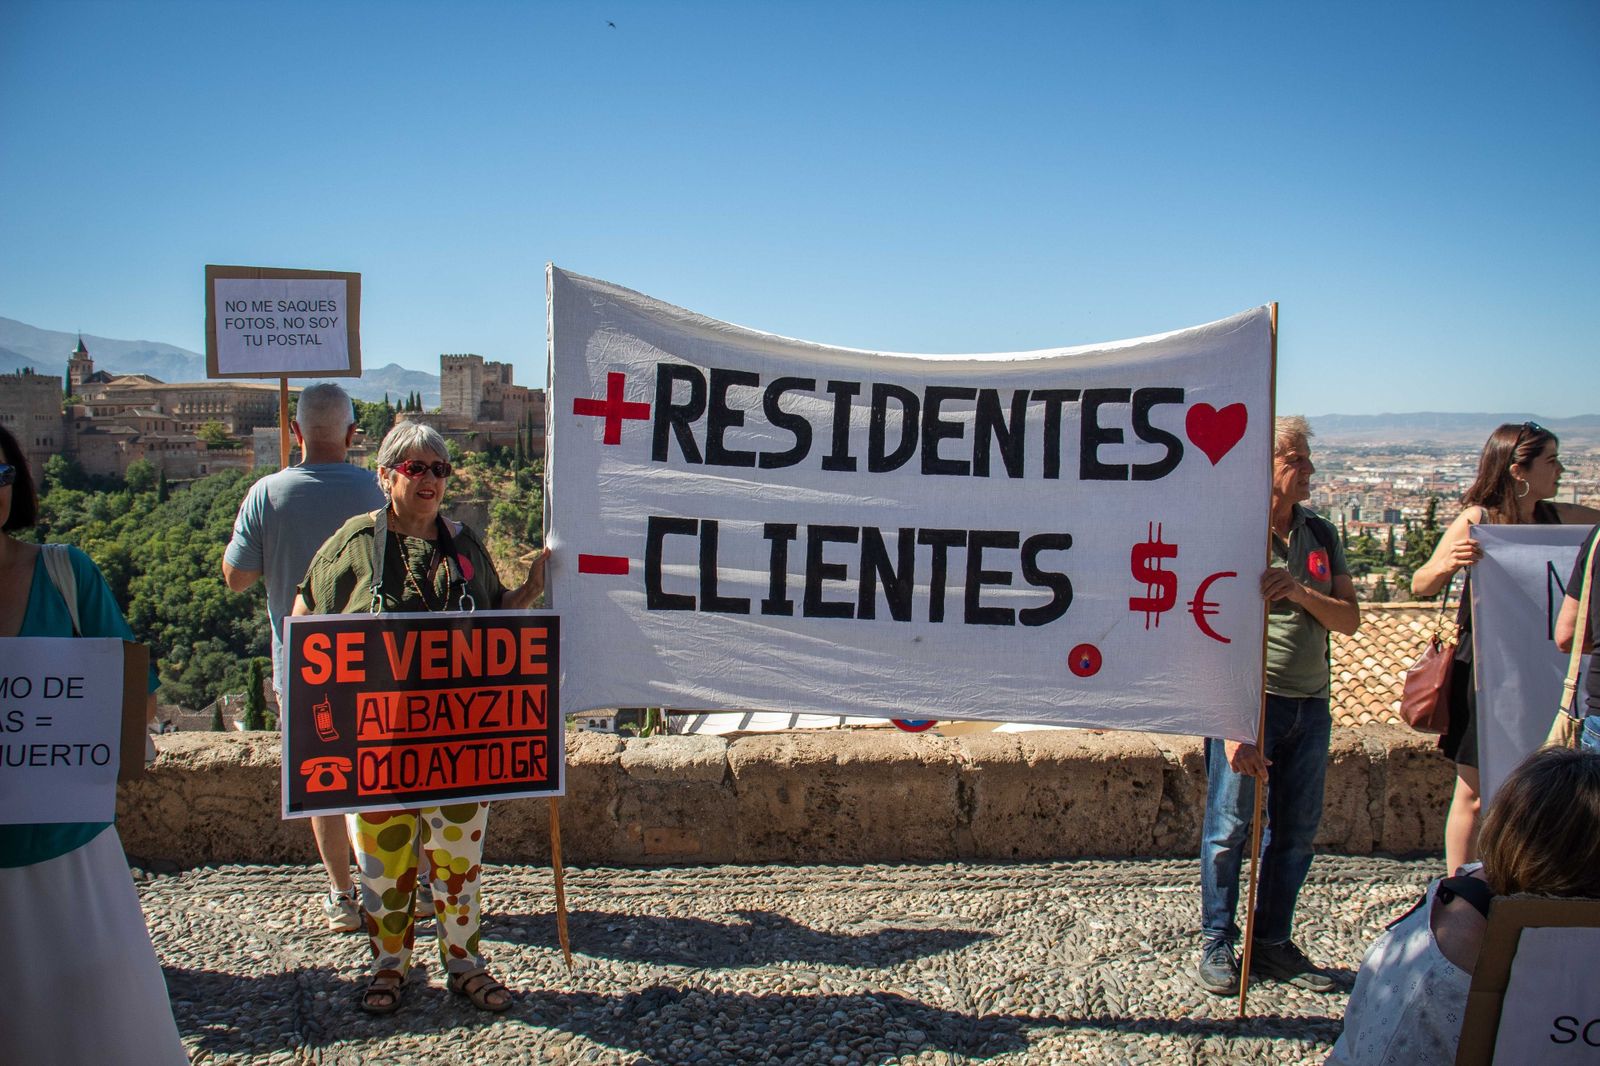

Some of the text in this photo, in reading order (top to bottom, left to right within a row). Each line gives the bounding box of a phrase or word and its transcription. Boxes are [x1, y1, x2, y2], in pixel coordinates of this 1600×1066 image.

[225, 300, 337, 313] NO ME SAQUES
[225, 317, 339, 331] FOTOS, NO SOY
[243, 333, 322, 346] TU POSTAL
[651, 362, 1185, 481] RESIDENTES
[644, 515, 1074, 627] CLIENTES
[301, 627, 548, 685] SE VENDE
[43, 677, 84, 699] DE
[0, 710, 24, 733] S
[356, 689, 547, 736] ALBAYZIN
[0, 743, 110, 767] UERTO
